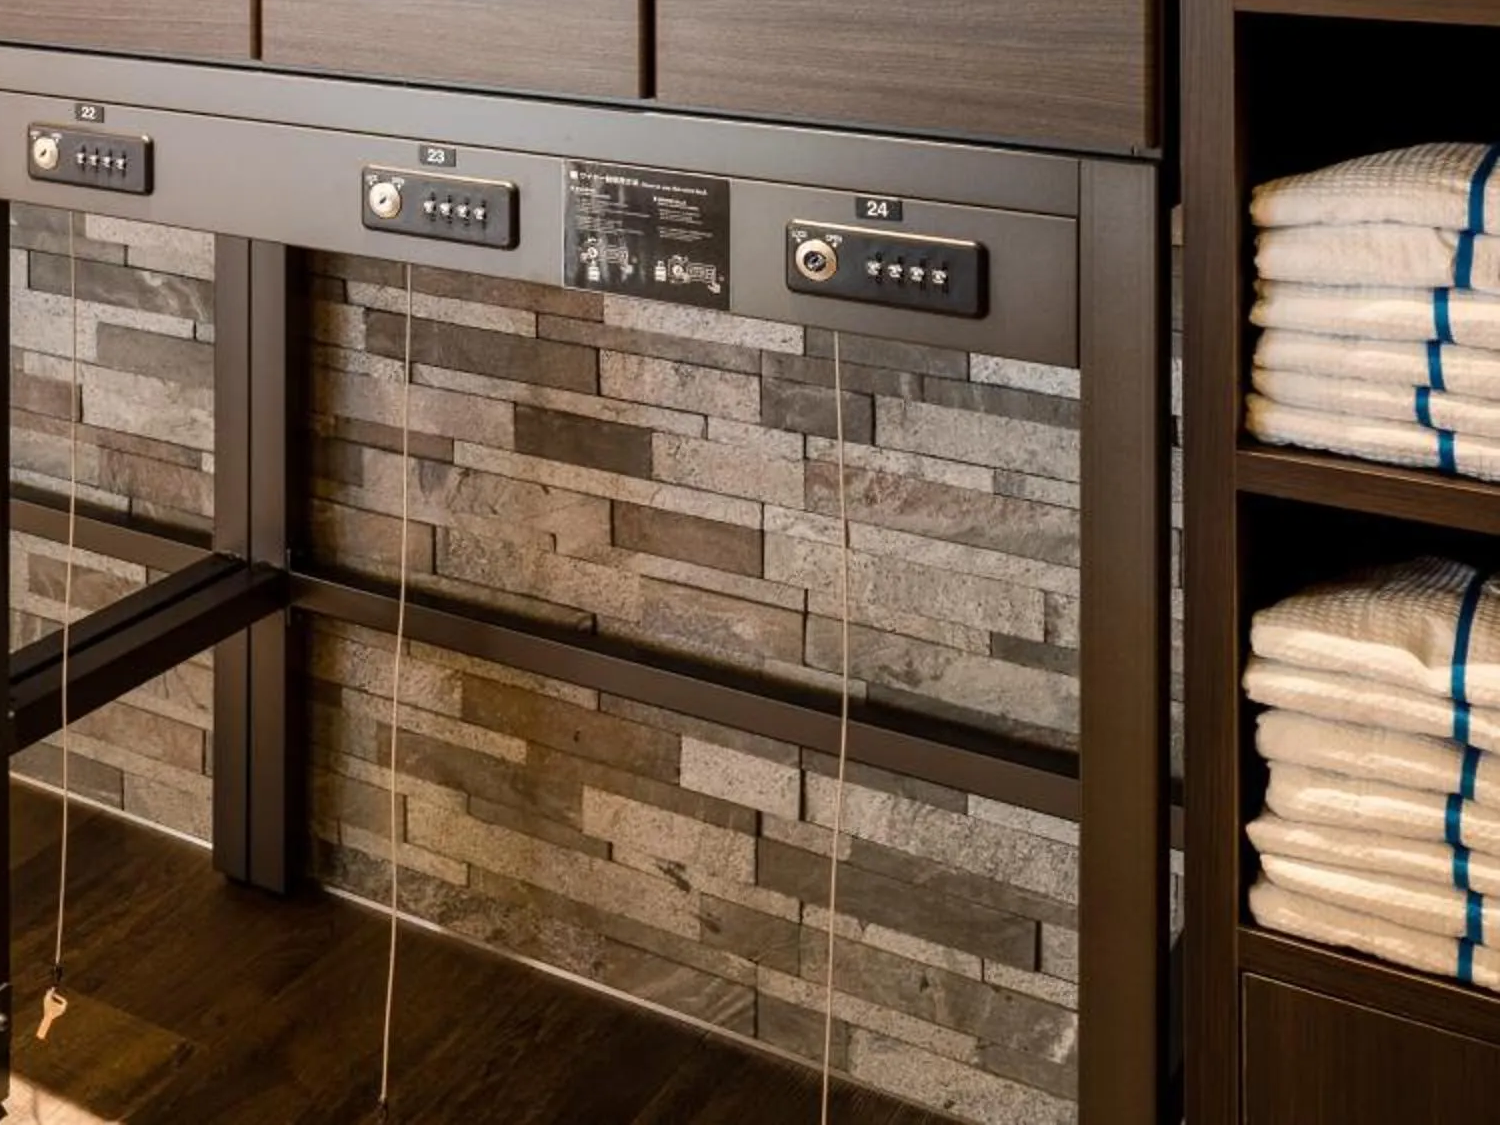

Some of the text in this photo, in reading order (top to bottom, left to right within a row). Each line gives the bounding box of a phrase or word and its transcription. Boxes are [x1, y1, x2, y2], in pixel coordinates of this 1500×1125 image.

[81, 106, 97, 120] 22
[427, 148, 445, 164] 23
[866, 200, 889, 218] 24
